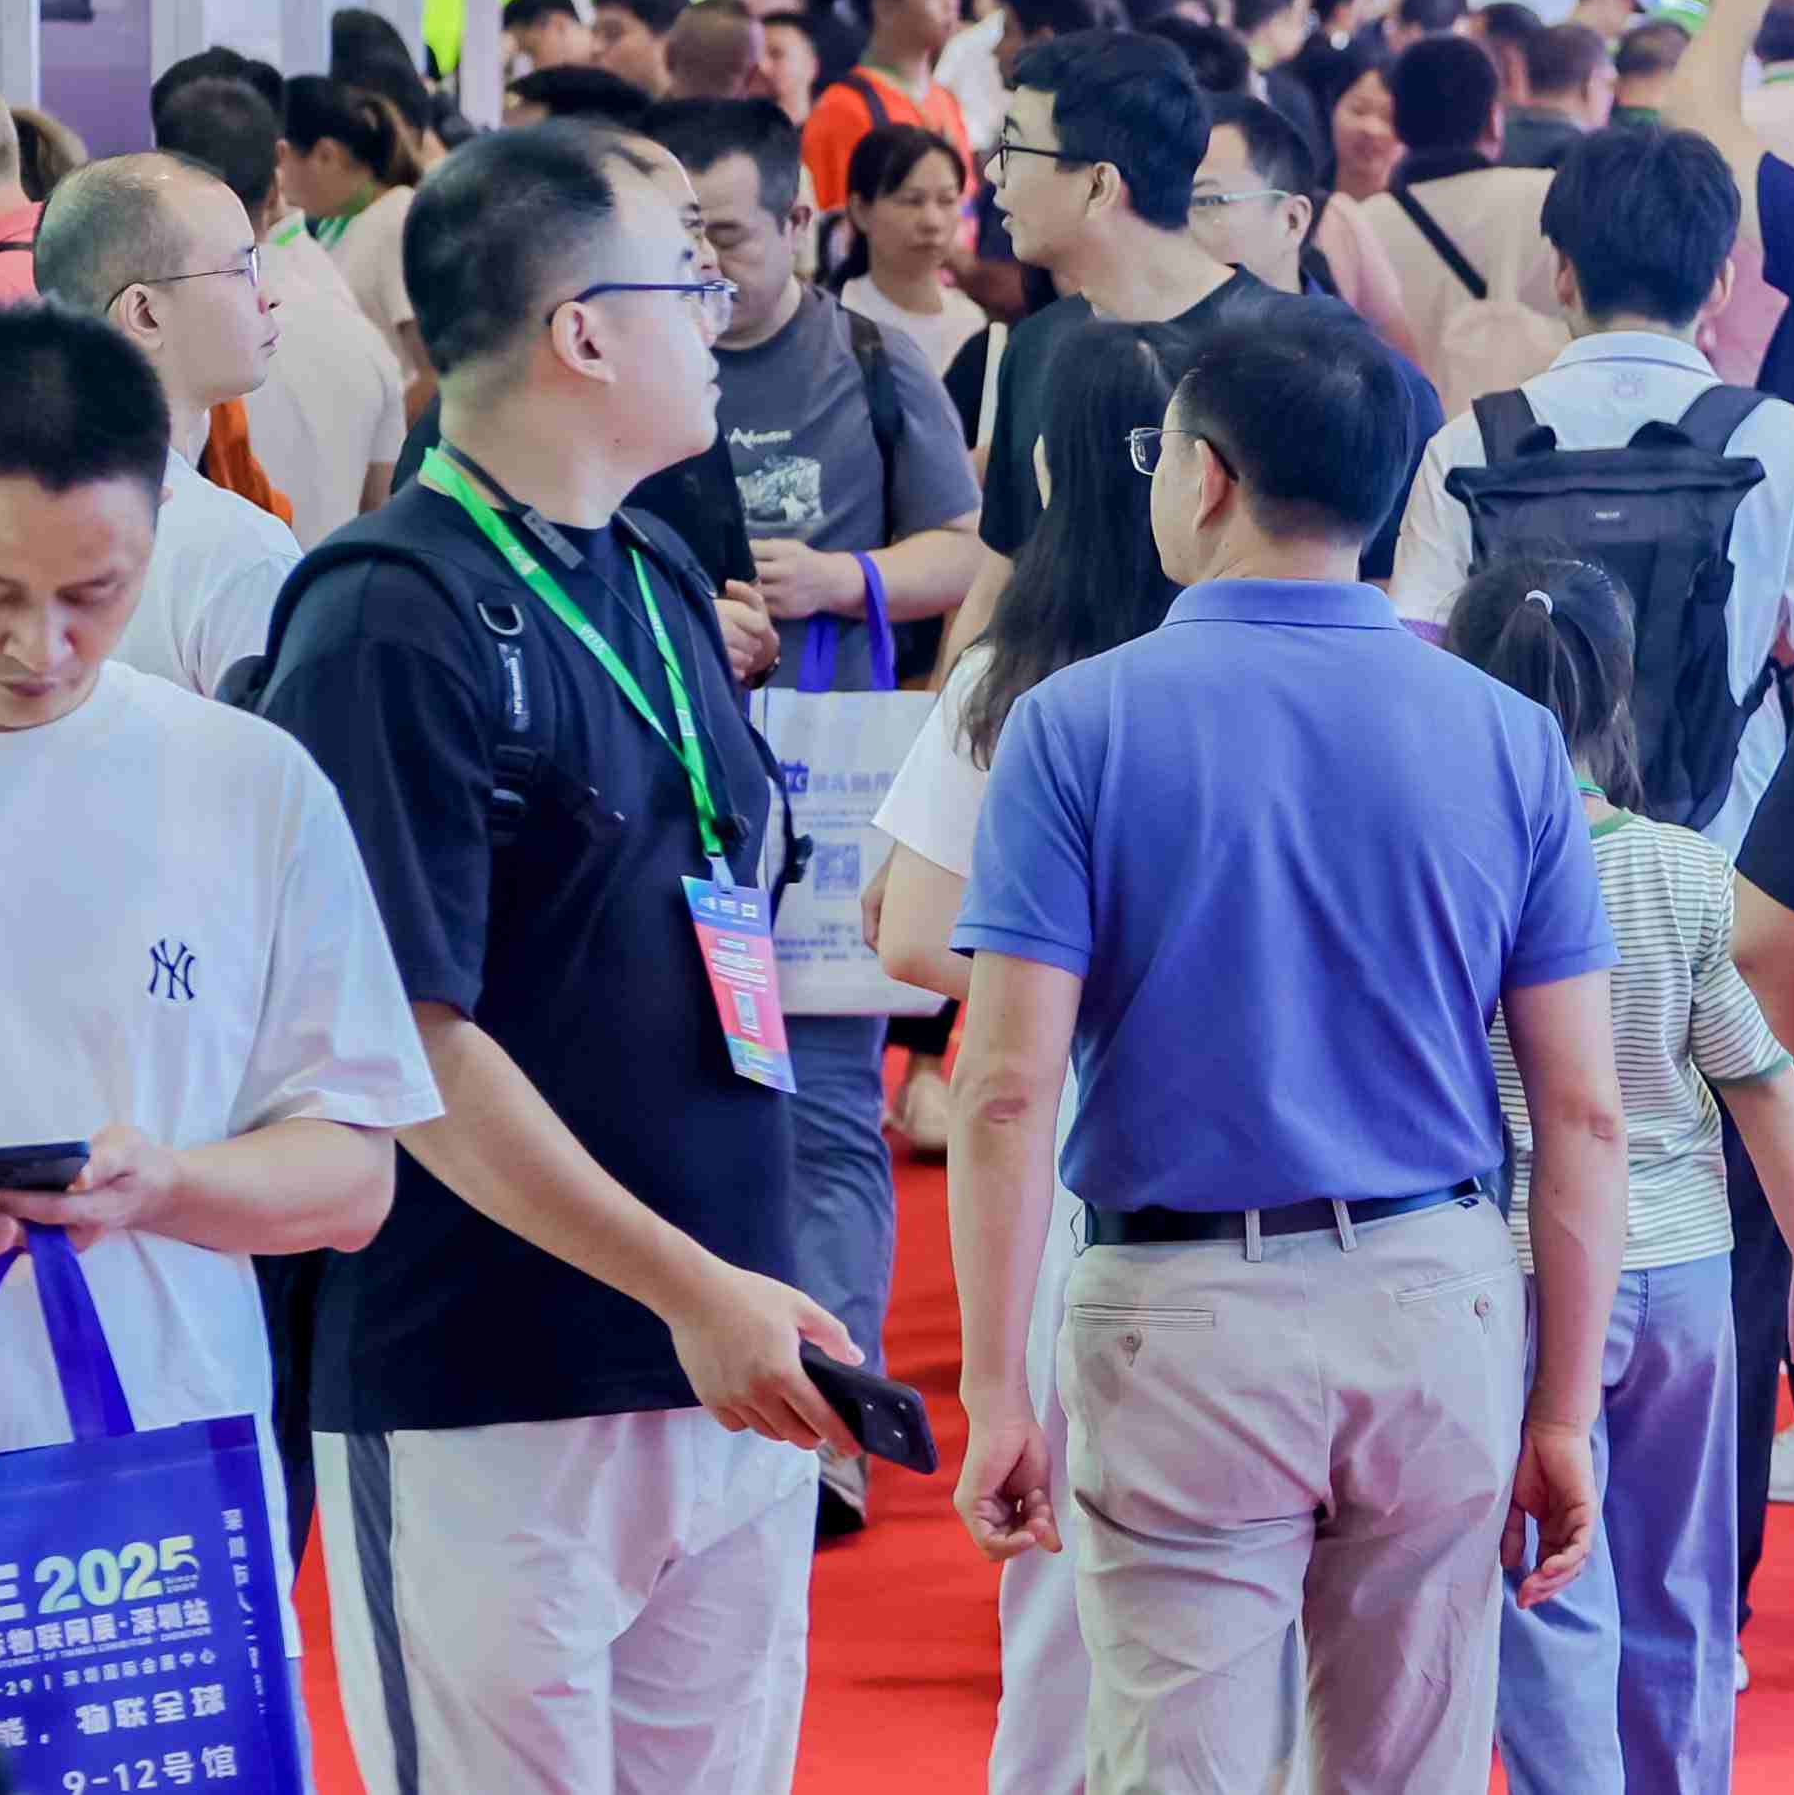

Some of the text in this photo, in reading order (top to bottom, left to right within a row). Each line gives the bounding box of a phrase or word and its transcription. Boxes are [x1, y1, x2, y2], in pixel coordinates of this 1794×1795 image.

[148, 938, 197, 1001] NY
[33, 1533, 201, 1615] 2025
[62, 1744, 238, 1795] 9-12号馆
